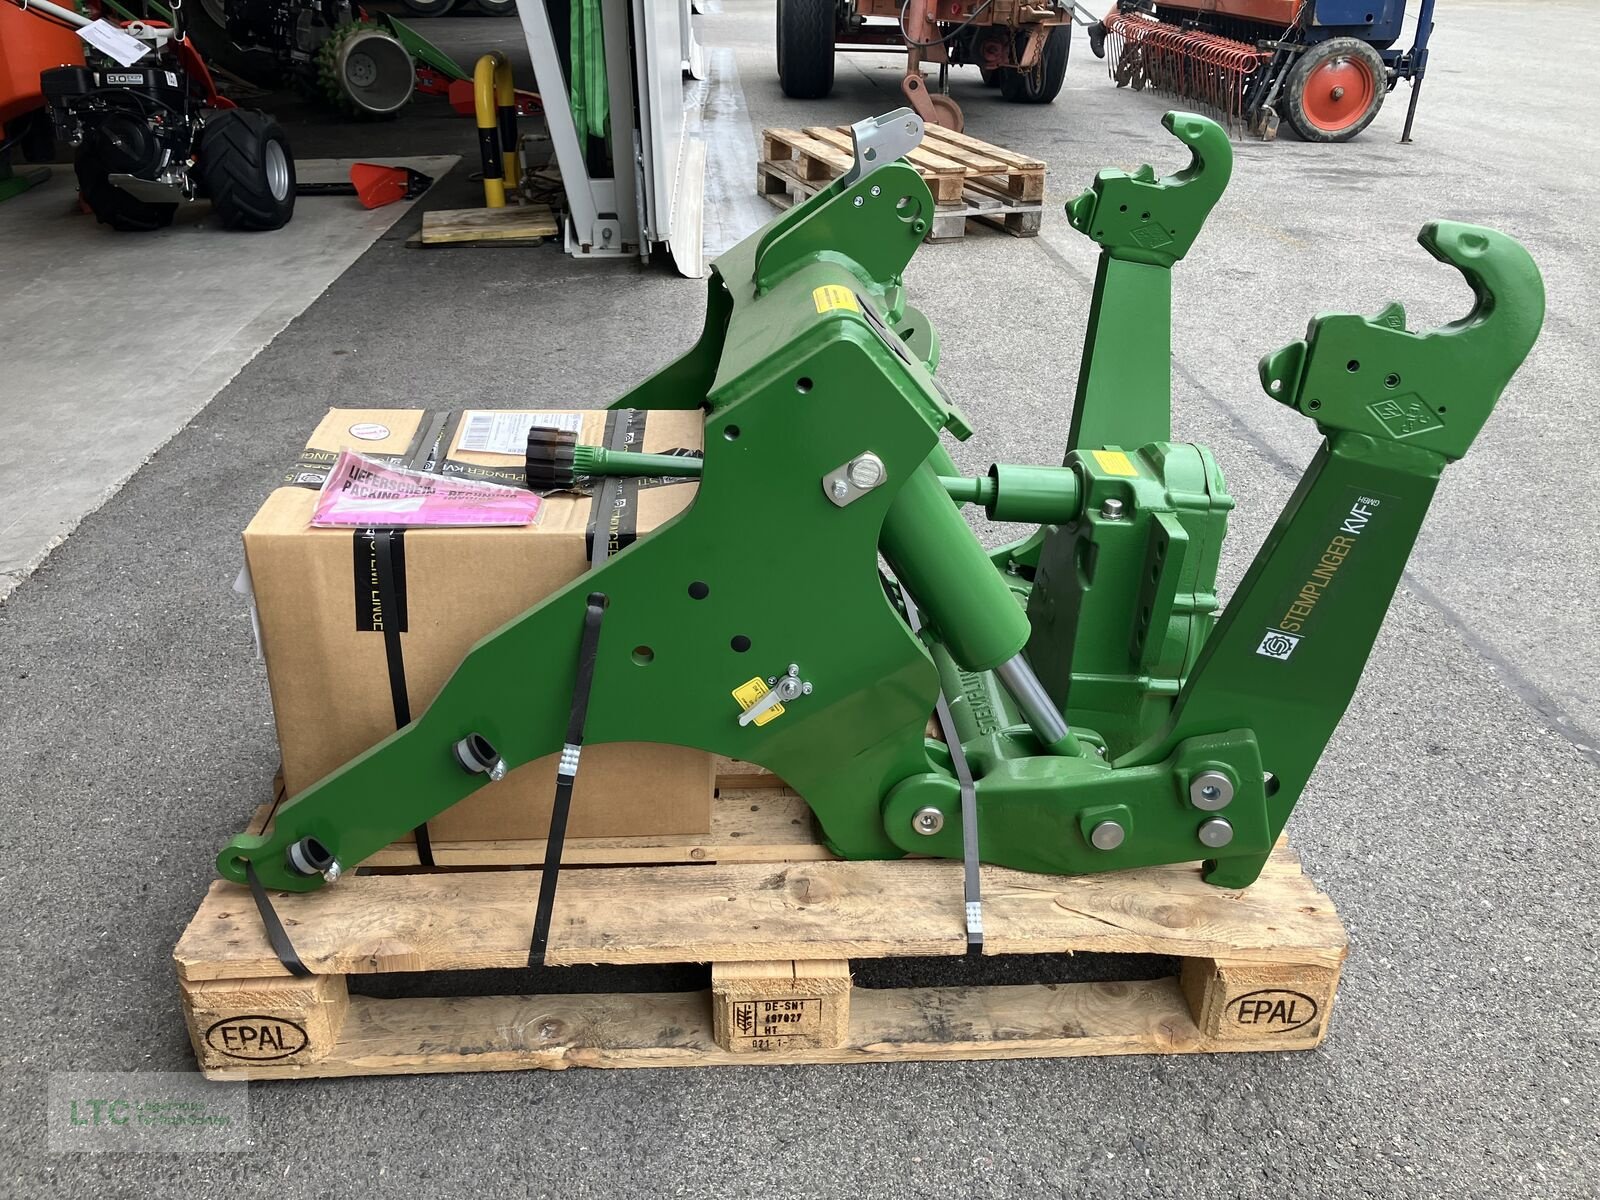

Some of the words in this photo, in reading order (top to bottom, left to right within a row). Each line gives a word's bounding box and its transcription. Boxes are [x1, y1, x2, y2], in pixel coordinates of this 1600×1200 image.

[349, 465, 436, 494] LIEFERSCHEIN
[1279, 535, 1356, 632] STEMPLINGER
[1340, 503, 1373, 535] KVF
[765, 1002, 804, 1011] DE-SN1
[1237, 1000, 1301, 1024] EPAL
[221, 1026, 295, 1051] EPAL
[764, 1026, 777, 1034] HT
